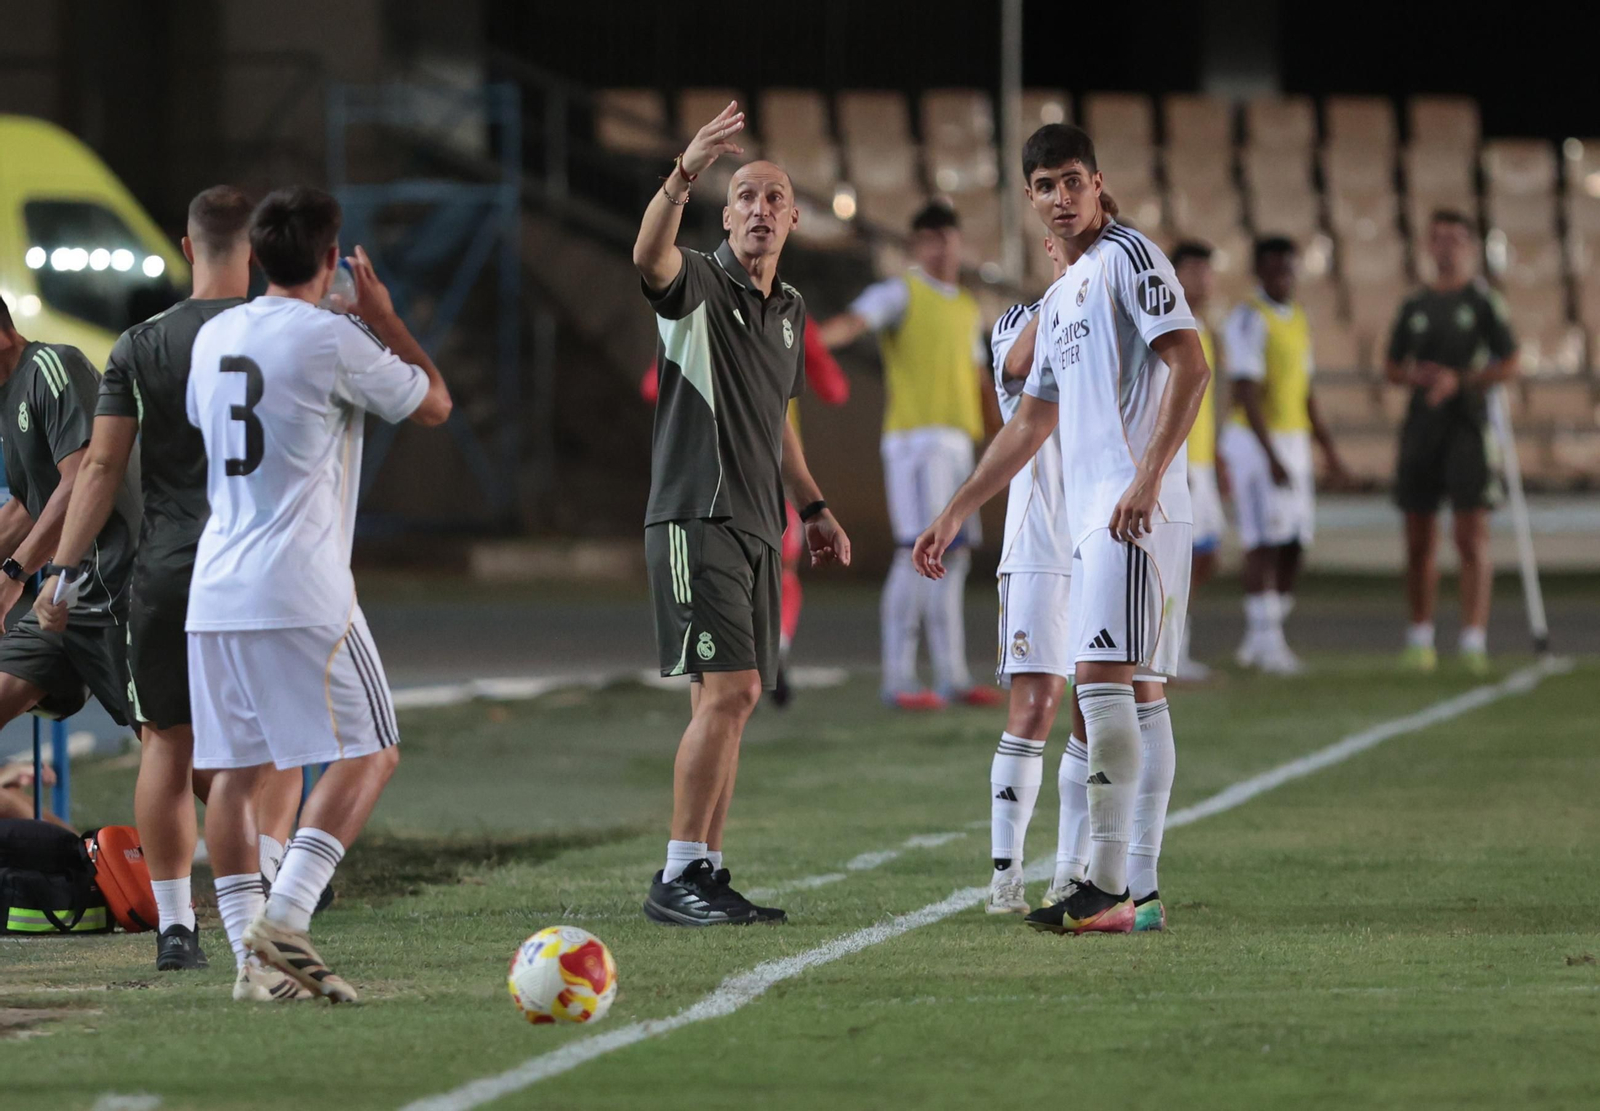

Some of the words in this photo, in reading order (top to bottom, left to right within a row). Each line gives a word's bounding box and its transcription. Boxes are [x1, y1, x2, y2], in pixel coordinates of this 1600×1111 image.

[1144, 275, 1171, 316] hp
[1059, 344, 1080, 370] ETTER
[219, 354, 265, 476] 3
